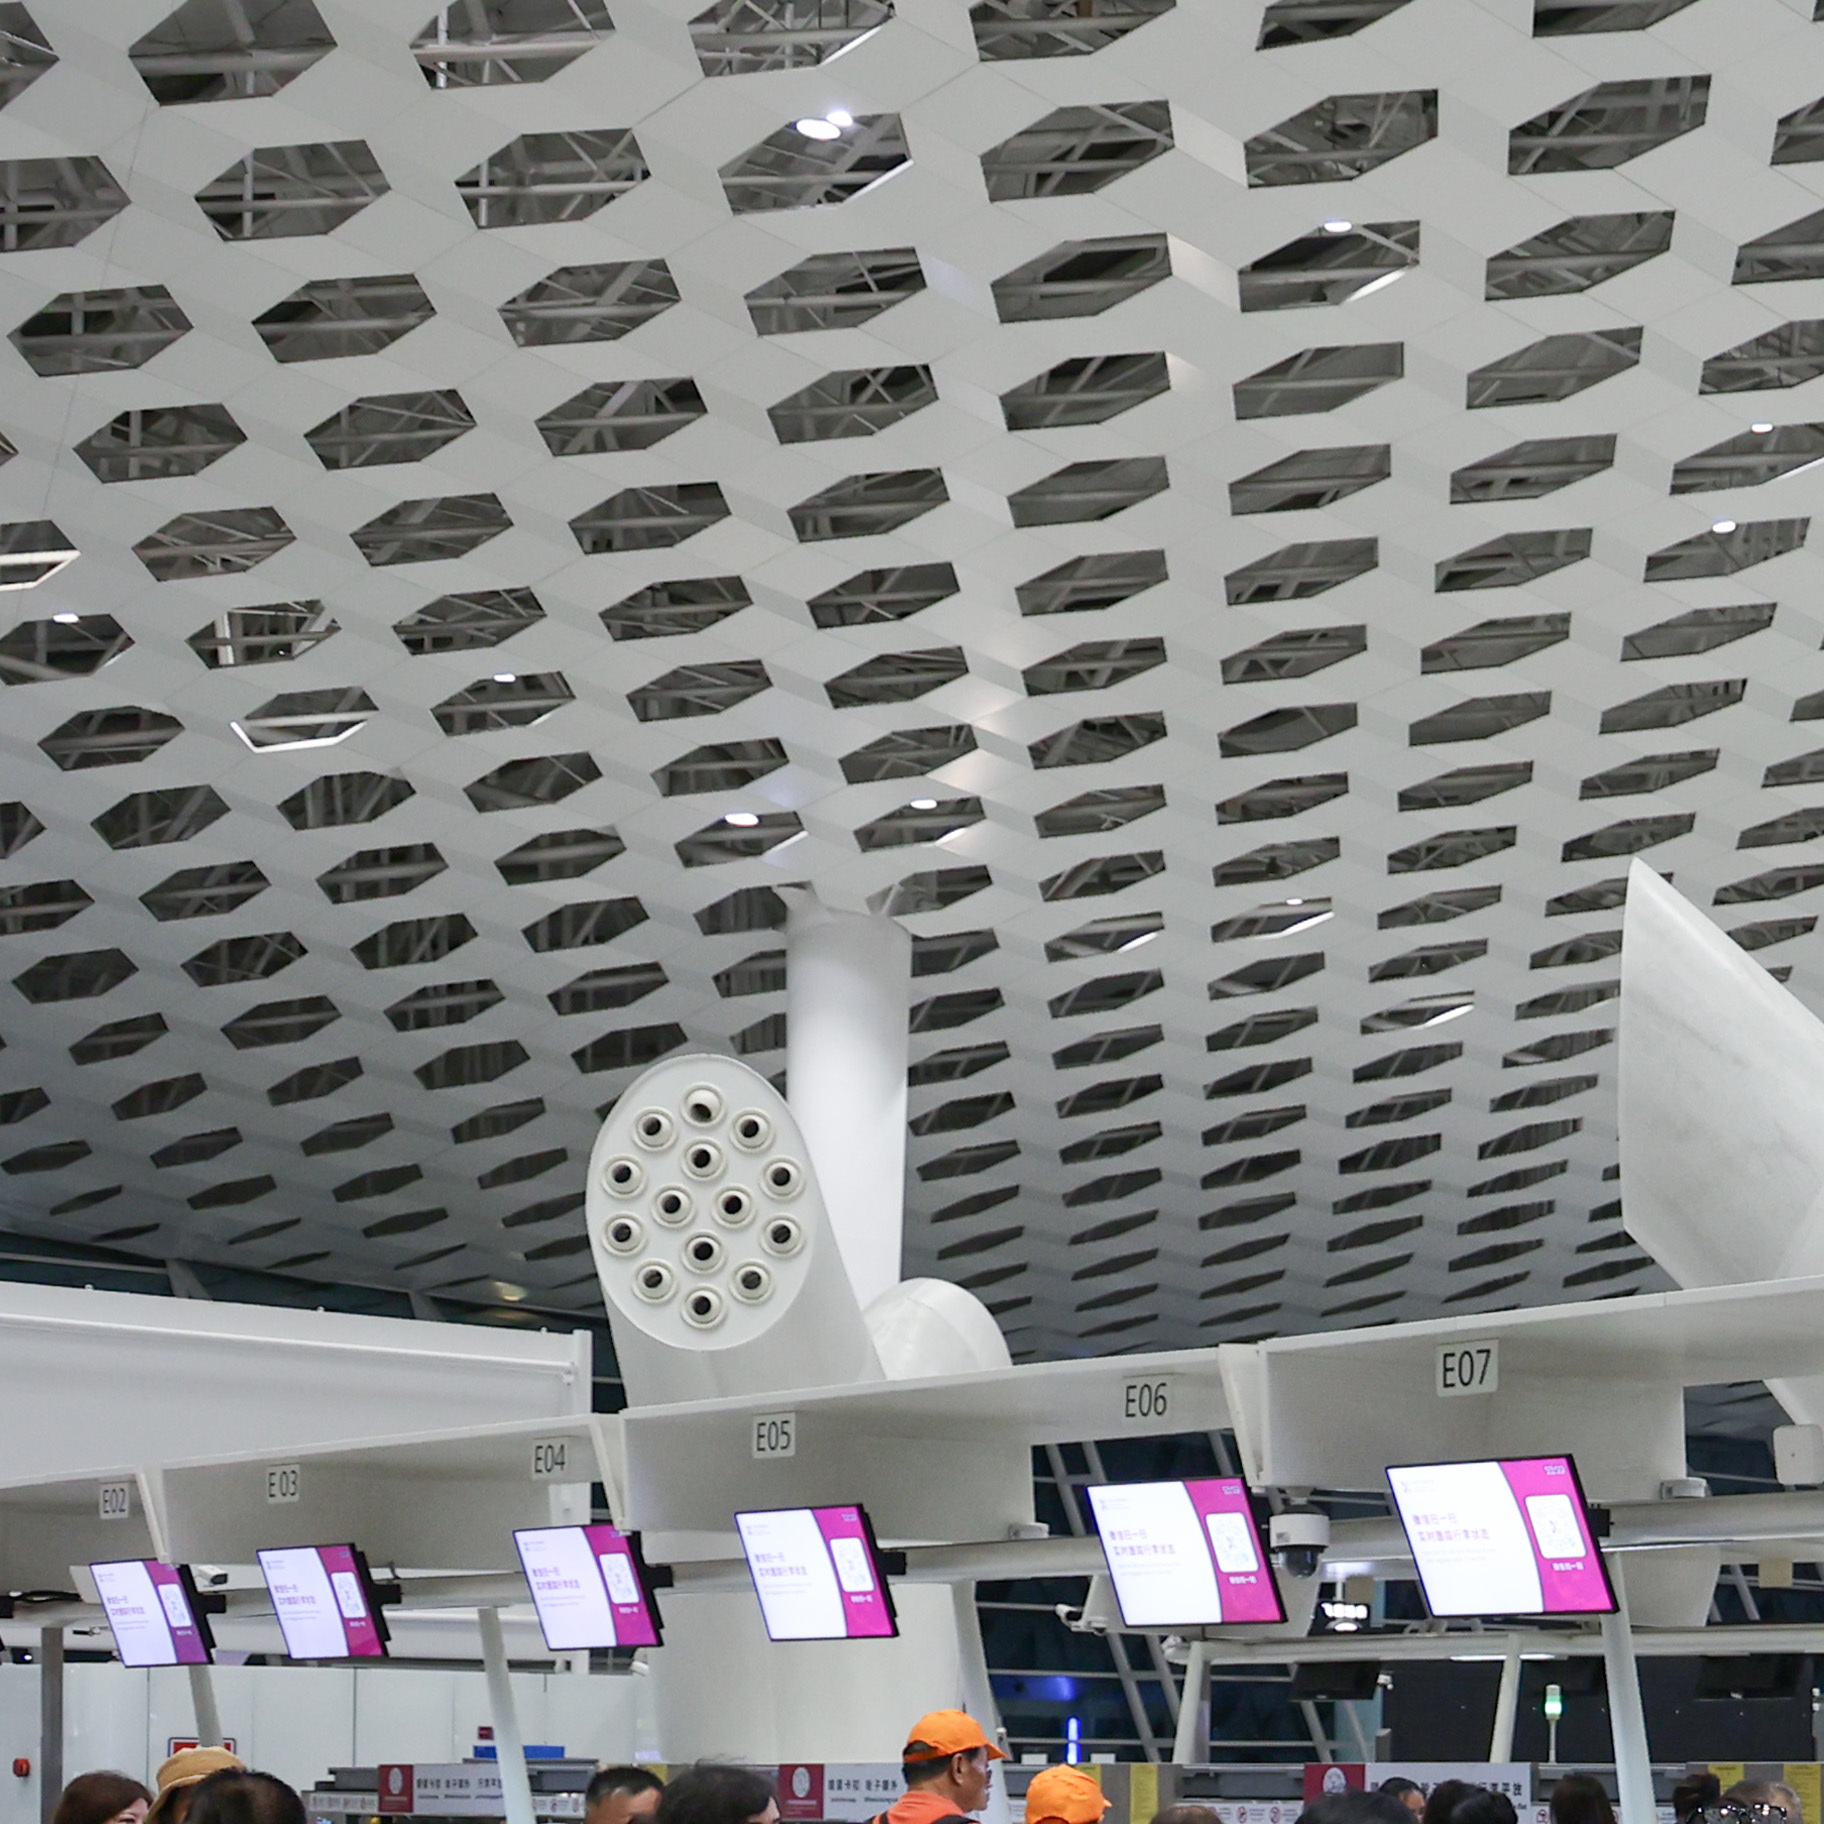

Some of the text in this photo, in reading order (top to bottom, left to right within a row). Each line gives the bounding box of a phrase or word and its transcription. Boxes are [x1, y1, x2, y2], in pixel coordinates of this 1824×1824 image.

[1443, 1349, 1491, 1388] E07
[1125, 1383, 1167, 1417] E06
[757, 1420, 790, 1451] E05
[534, 1444, 565, 1474] E04
[268, 1471, 297, 1498] E03
[103, 1488, 126, 1513] E02
